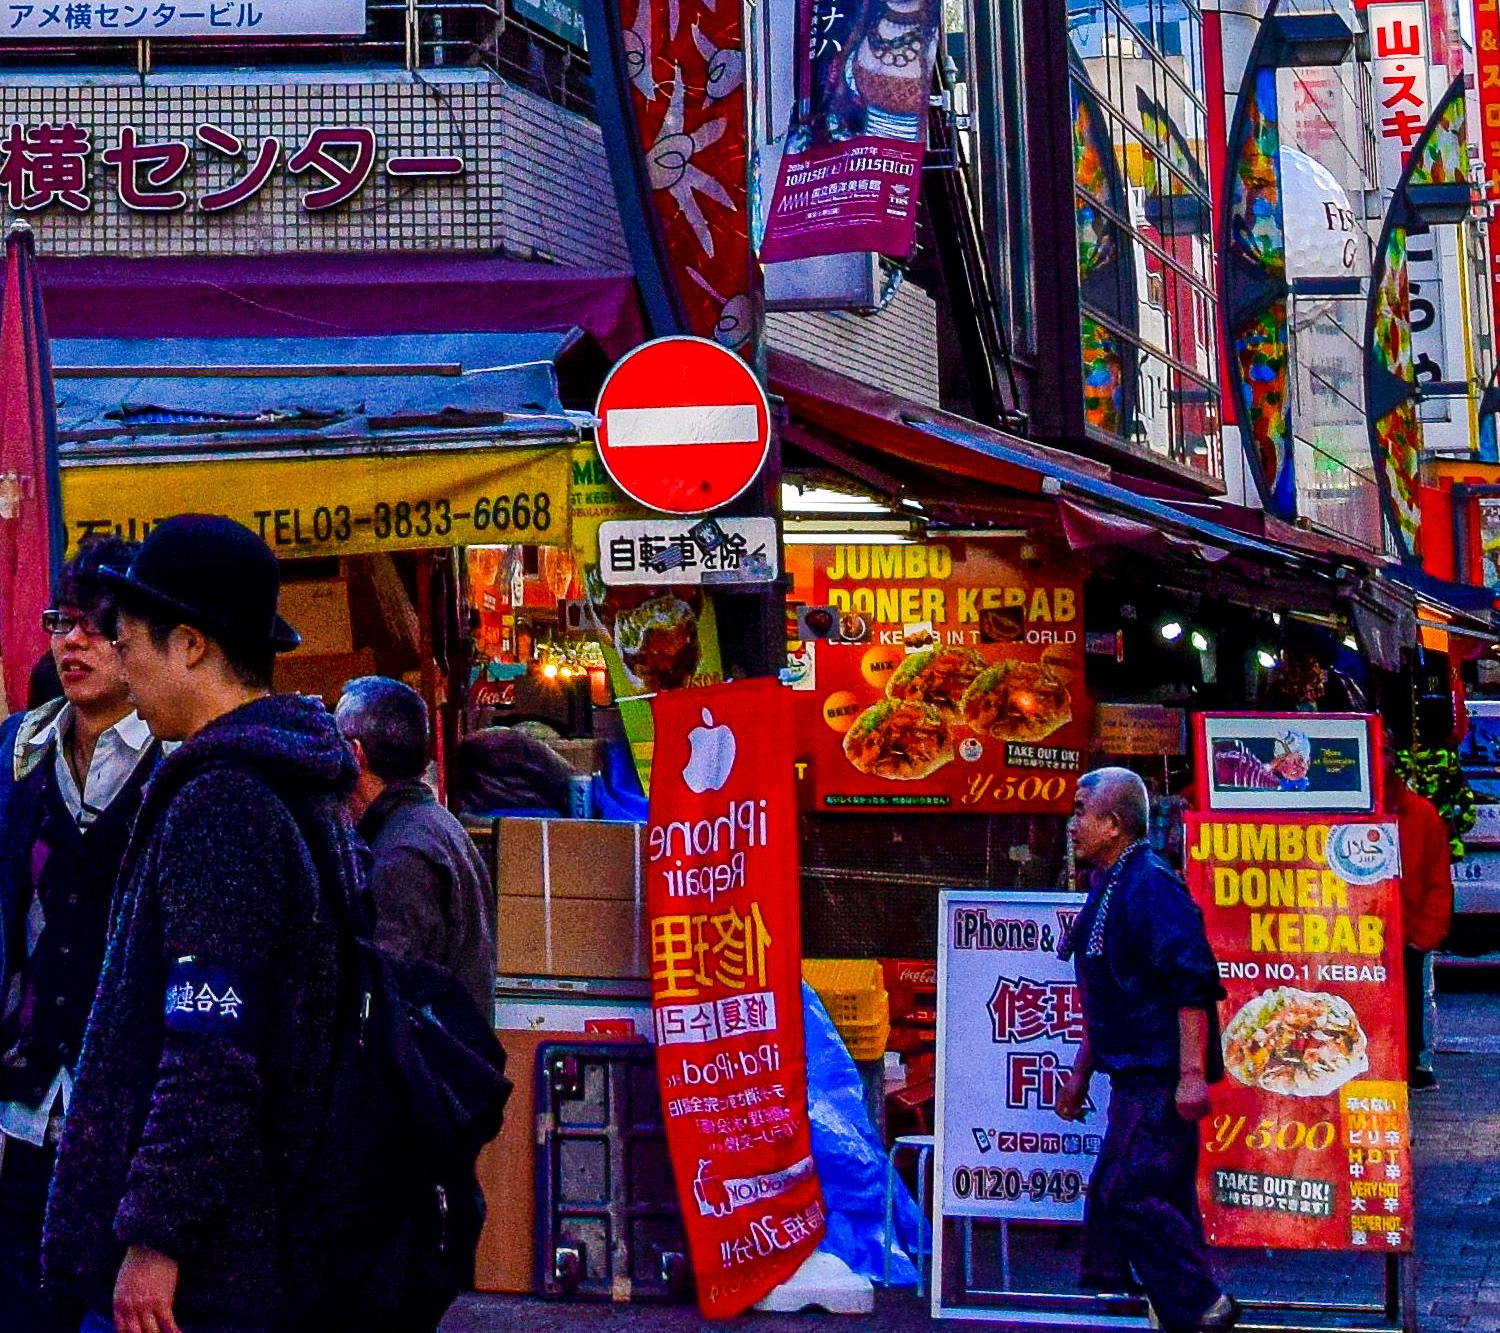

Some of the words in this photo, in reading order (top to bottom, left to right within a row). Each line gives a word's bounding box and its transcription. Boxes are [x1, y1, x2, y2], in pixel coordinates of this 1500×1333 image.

[8, 0, 264, 33] アメ横センタービル
[253, 490, 553, 547] TEL03-3833-6668
[826, 544, 953, 580] JUMBO
[947, 629, 965, 645] IN
[1013, 629, 1078, 646] ORLD
[1007, 744, 1035, 759] TAKE
[1037, 745, 1059, 761] OUT
[1190, 822, 1331, 863] JUMBO
[1213, 866, 1348, 909] DONER
[953, 907, 1039, 951] iPhone
[1040, 924, 1056, 953] &
[1250, 912, 1385, 956] KEBAB
[1265, 963, 1310, 981] NO.1
[1316, 964, 1388, 984] KEBAB
[1350, 1115, 1399, 1130] MIX
[1348, 1148, 1400, 1164] HOT
[1215, 1170, 1258, 1194] TAKE
[1262, 1176, 1297, 1198] OUT
[1300, 1180, 1331, 1202] OK!
